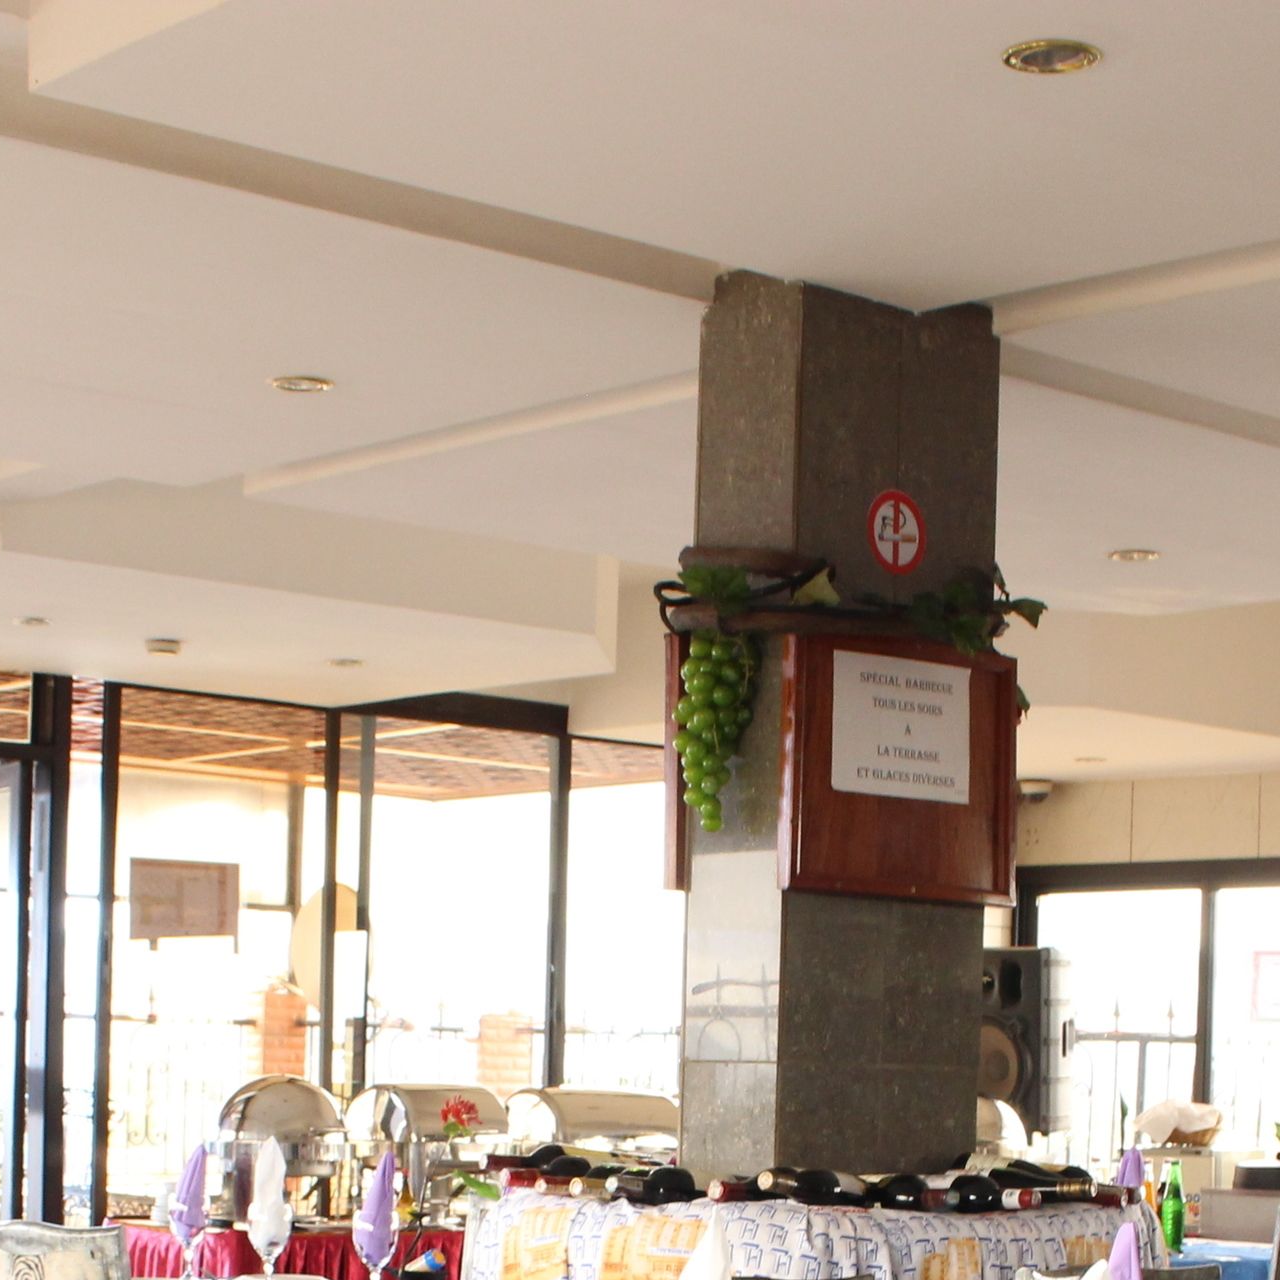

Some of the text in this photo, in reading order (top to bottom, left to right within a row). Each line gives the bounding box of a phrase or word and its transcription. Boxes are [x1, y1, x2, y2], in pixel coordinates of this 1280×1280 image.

[872, 696, 943, 716] TOUS LES SOIRS
[876, 744, 941, 763] LA TERRASSE
[856, 766, 956, 788] ET GLACES DIVERSES
